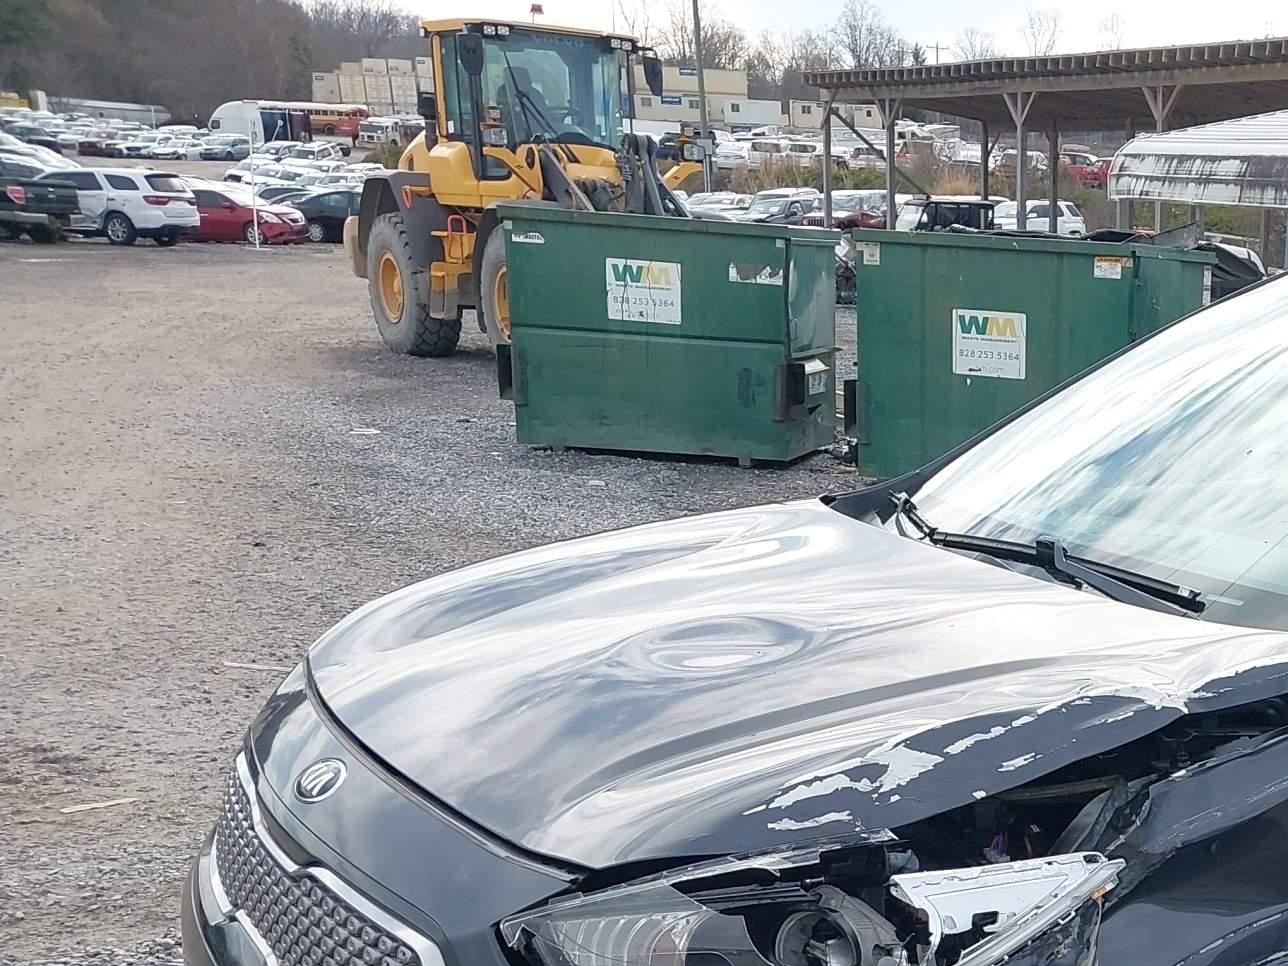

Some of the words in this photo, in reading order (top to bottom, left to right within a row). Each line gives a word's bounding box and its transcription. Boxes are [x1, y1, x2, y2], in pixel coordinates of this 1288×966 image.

[611, 264, 672, 286] WM
[632, 297, 649, 306] 253
[958, 315, 1017, 337] WM
[959, 348, 975, 358] 828
[977, 350, 994, 359] 253
[996, 352, 1019, 361] 5364
